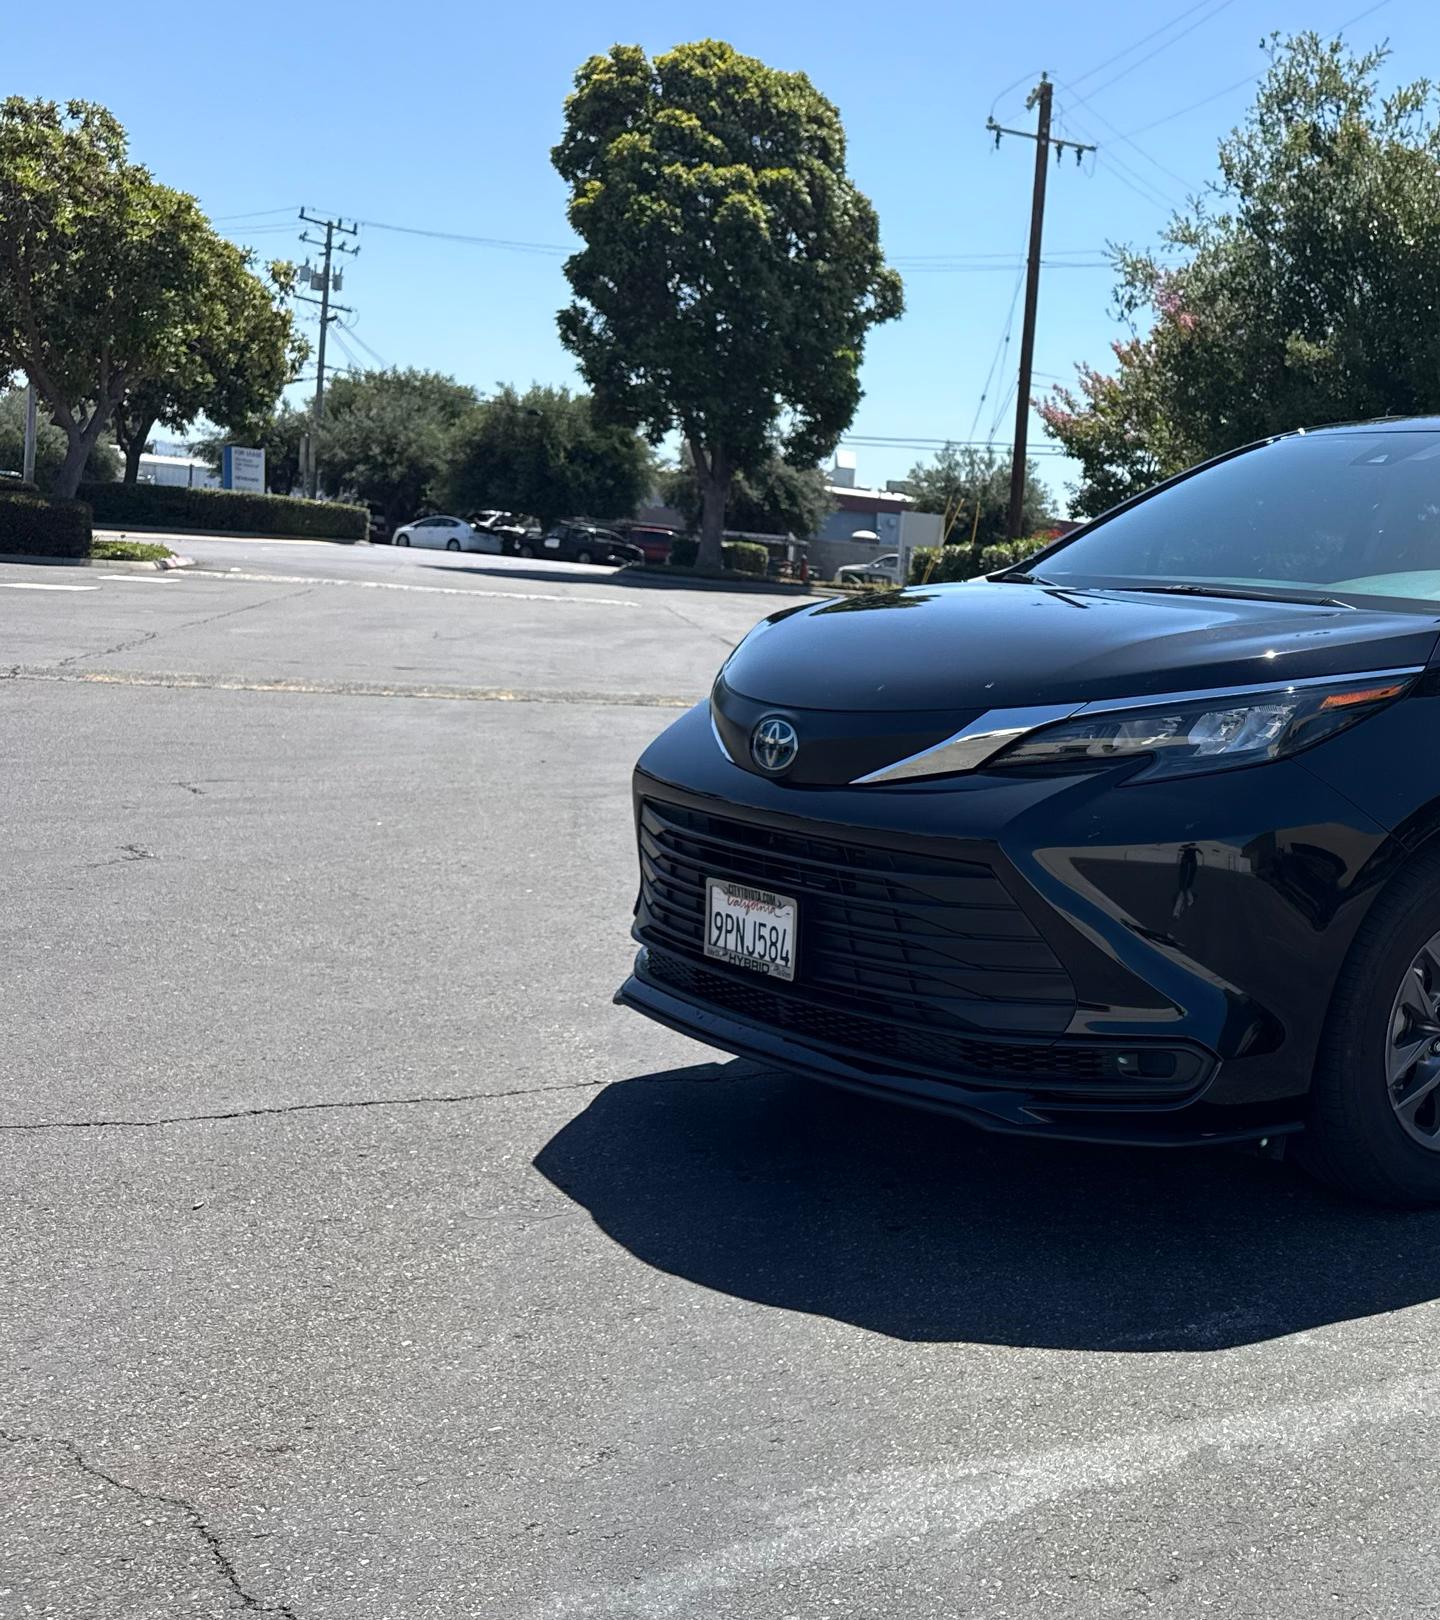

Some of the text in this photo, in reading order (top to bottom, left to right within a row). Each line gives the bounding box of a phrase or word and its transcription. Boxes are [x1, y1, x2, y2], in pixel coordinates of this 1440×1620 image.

[727, 896, 784, 916] California
[713, 911, 790, 967] 9PNJ584
[728, 952, 770, 974] HYBRID
